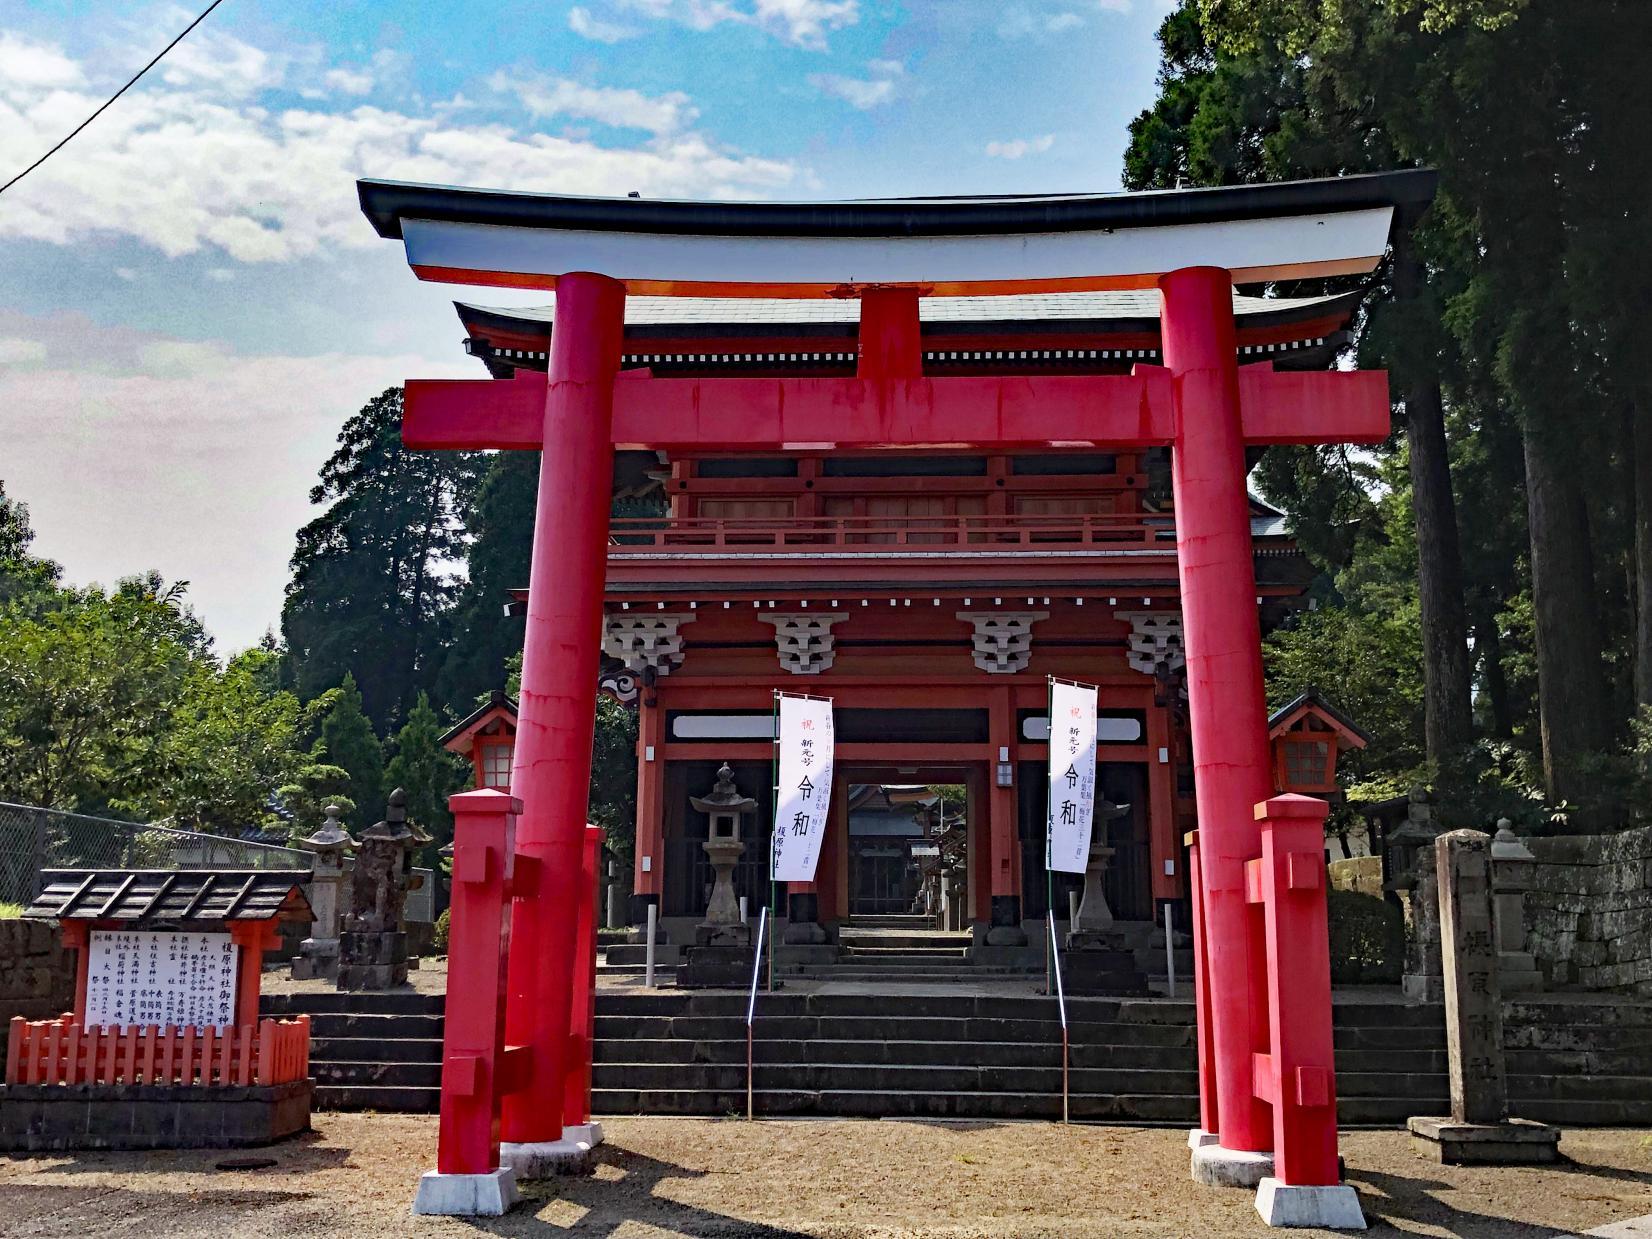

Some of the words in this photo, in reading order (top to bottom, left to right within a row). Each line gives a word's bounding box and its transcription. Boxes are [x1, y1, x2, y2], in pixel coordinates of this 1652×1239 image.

[801, 719, 815, 731] 祝
[1070, 706, 1082, 719] 祝
[801, 739, 814, 767] 新元号
[792, 774, 815, 837] 令和
[1060, 763, 1079, 826] 令和
